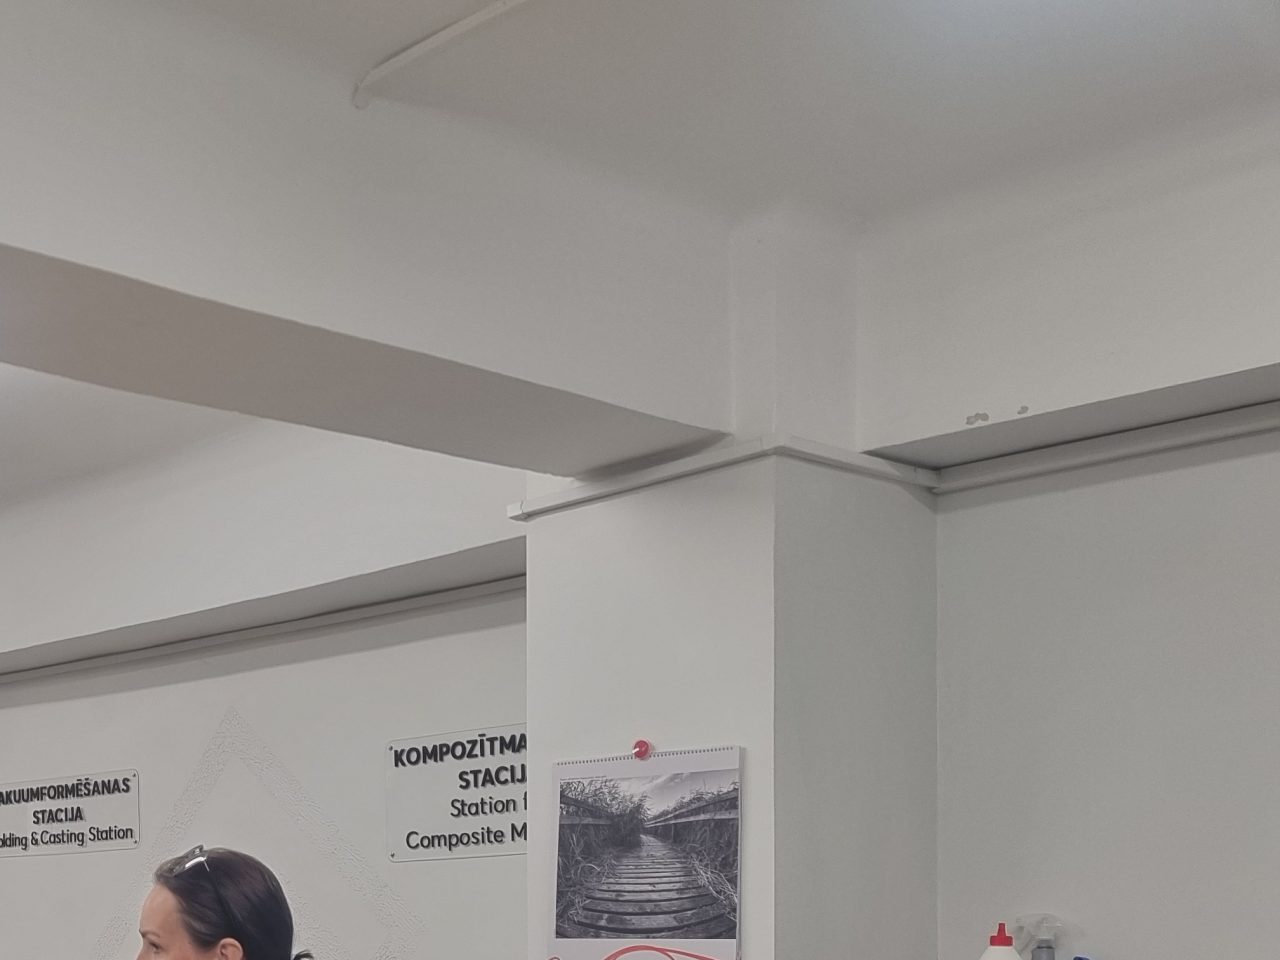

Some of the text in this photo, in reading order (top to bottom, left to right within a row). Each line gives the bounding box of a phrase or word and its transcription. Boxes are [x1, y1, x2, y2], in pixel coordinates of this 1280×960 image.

[458, 763, 527, 790] STACIJ
[32, 806, 84, 825] STACIJA
[450, 796, 517, 818] Station
[30, 831, 40, 847] &
[40, 829, 86, 847] Casting
[88, 825, 134, 842] Station
[405, 826, 506, 852] Composite
